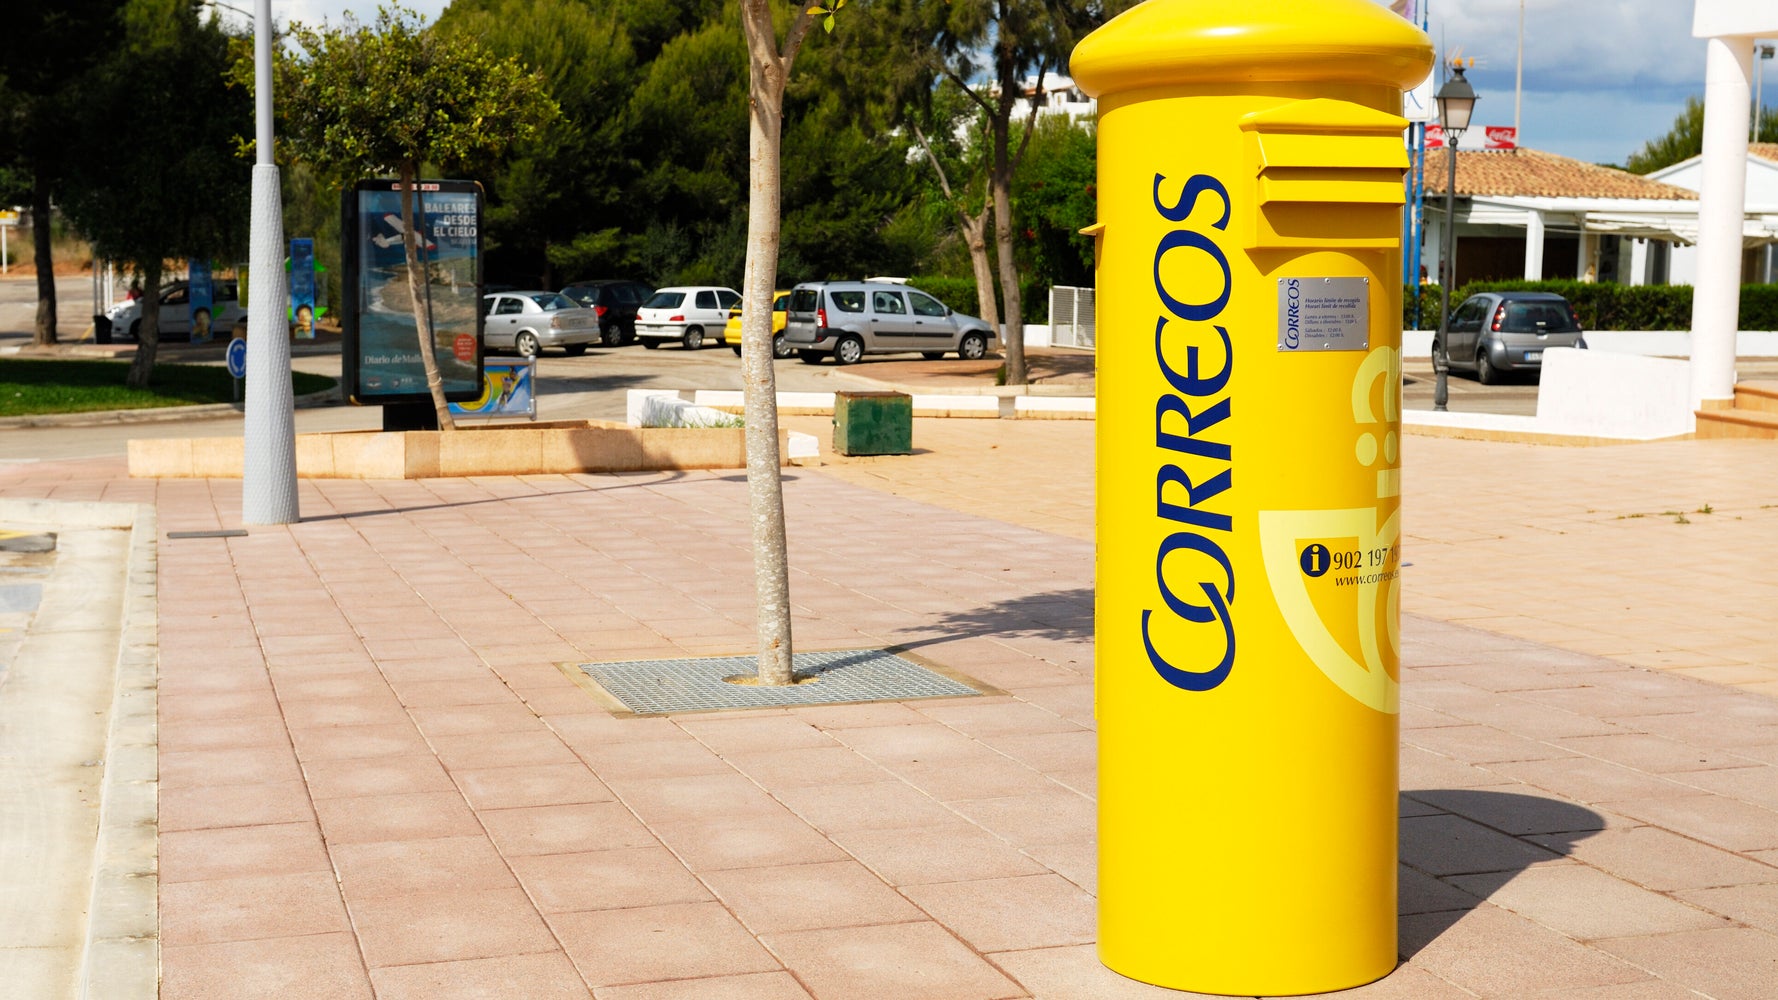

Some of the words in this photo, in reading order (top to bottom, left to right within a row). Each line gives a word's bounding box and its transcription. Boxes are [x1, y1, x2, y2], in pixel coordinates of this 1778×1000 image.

[424, 202, 477, 213] BALEARES
[443, 215, 477, 225] DESDE
[433, 226, 446, 237] EL
[447, 226, 477, 237] CIELO
[1285, 279, 1300, 349] CORREOS
[364, 355, 390, 365] Diario
[1142, 172, 1236, 692] CORREOS
[1333, 551, 1362, 570] 902
[1367, 547, 1388, 567] 197
[1335, 569, 1400, 587] www.correos.e
